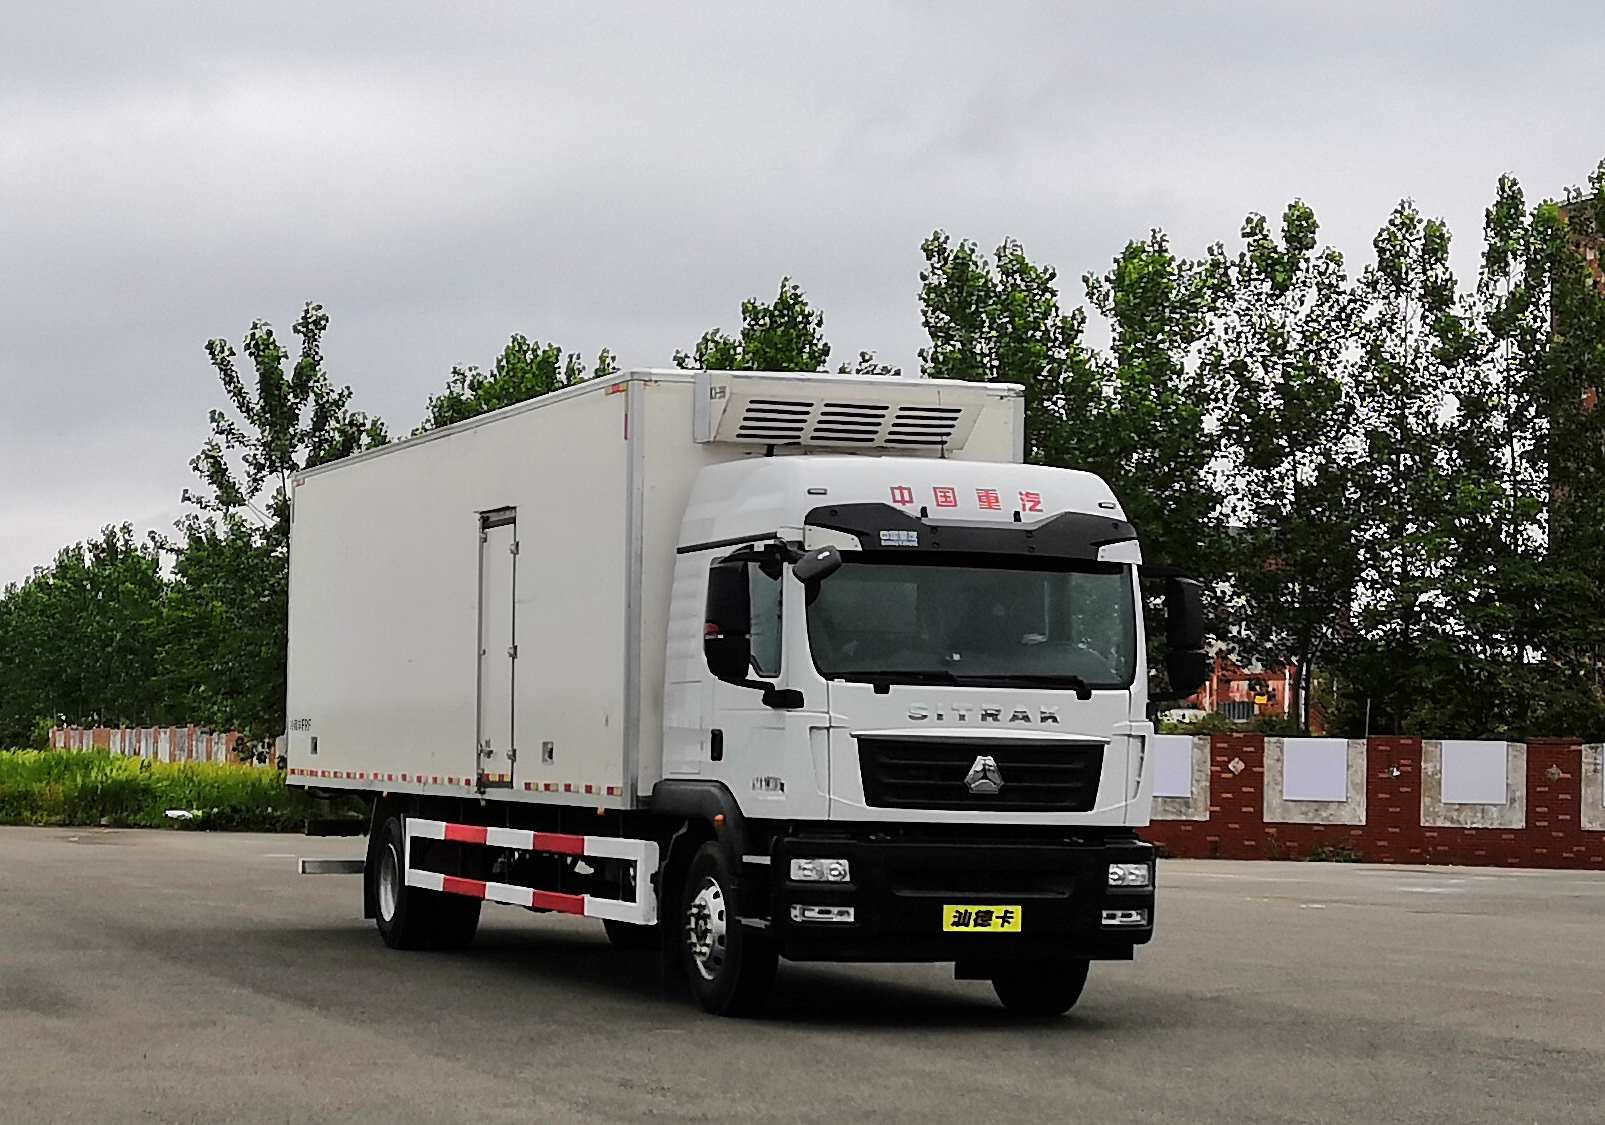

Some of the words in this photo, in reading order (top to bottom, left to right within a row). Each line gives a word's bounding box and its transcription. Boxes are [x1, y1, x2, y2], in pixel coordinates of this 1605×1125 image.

[890, 485, 1043, 512] 中国重汽
[907, 702, 1060, 724] SITRAK
[950, 908, 1015, 928] 汕德卡
